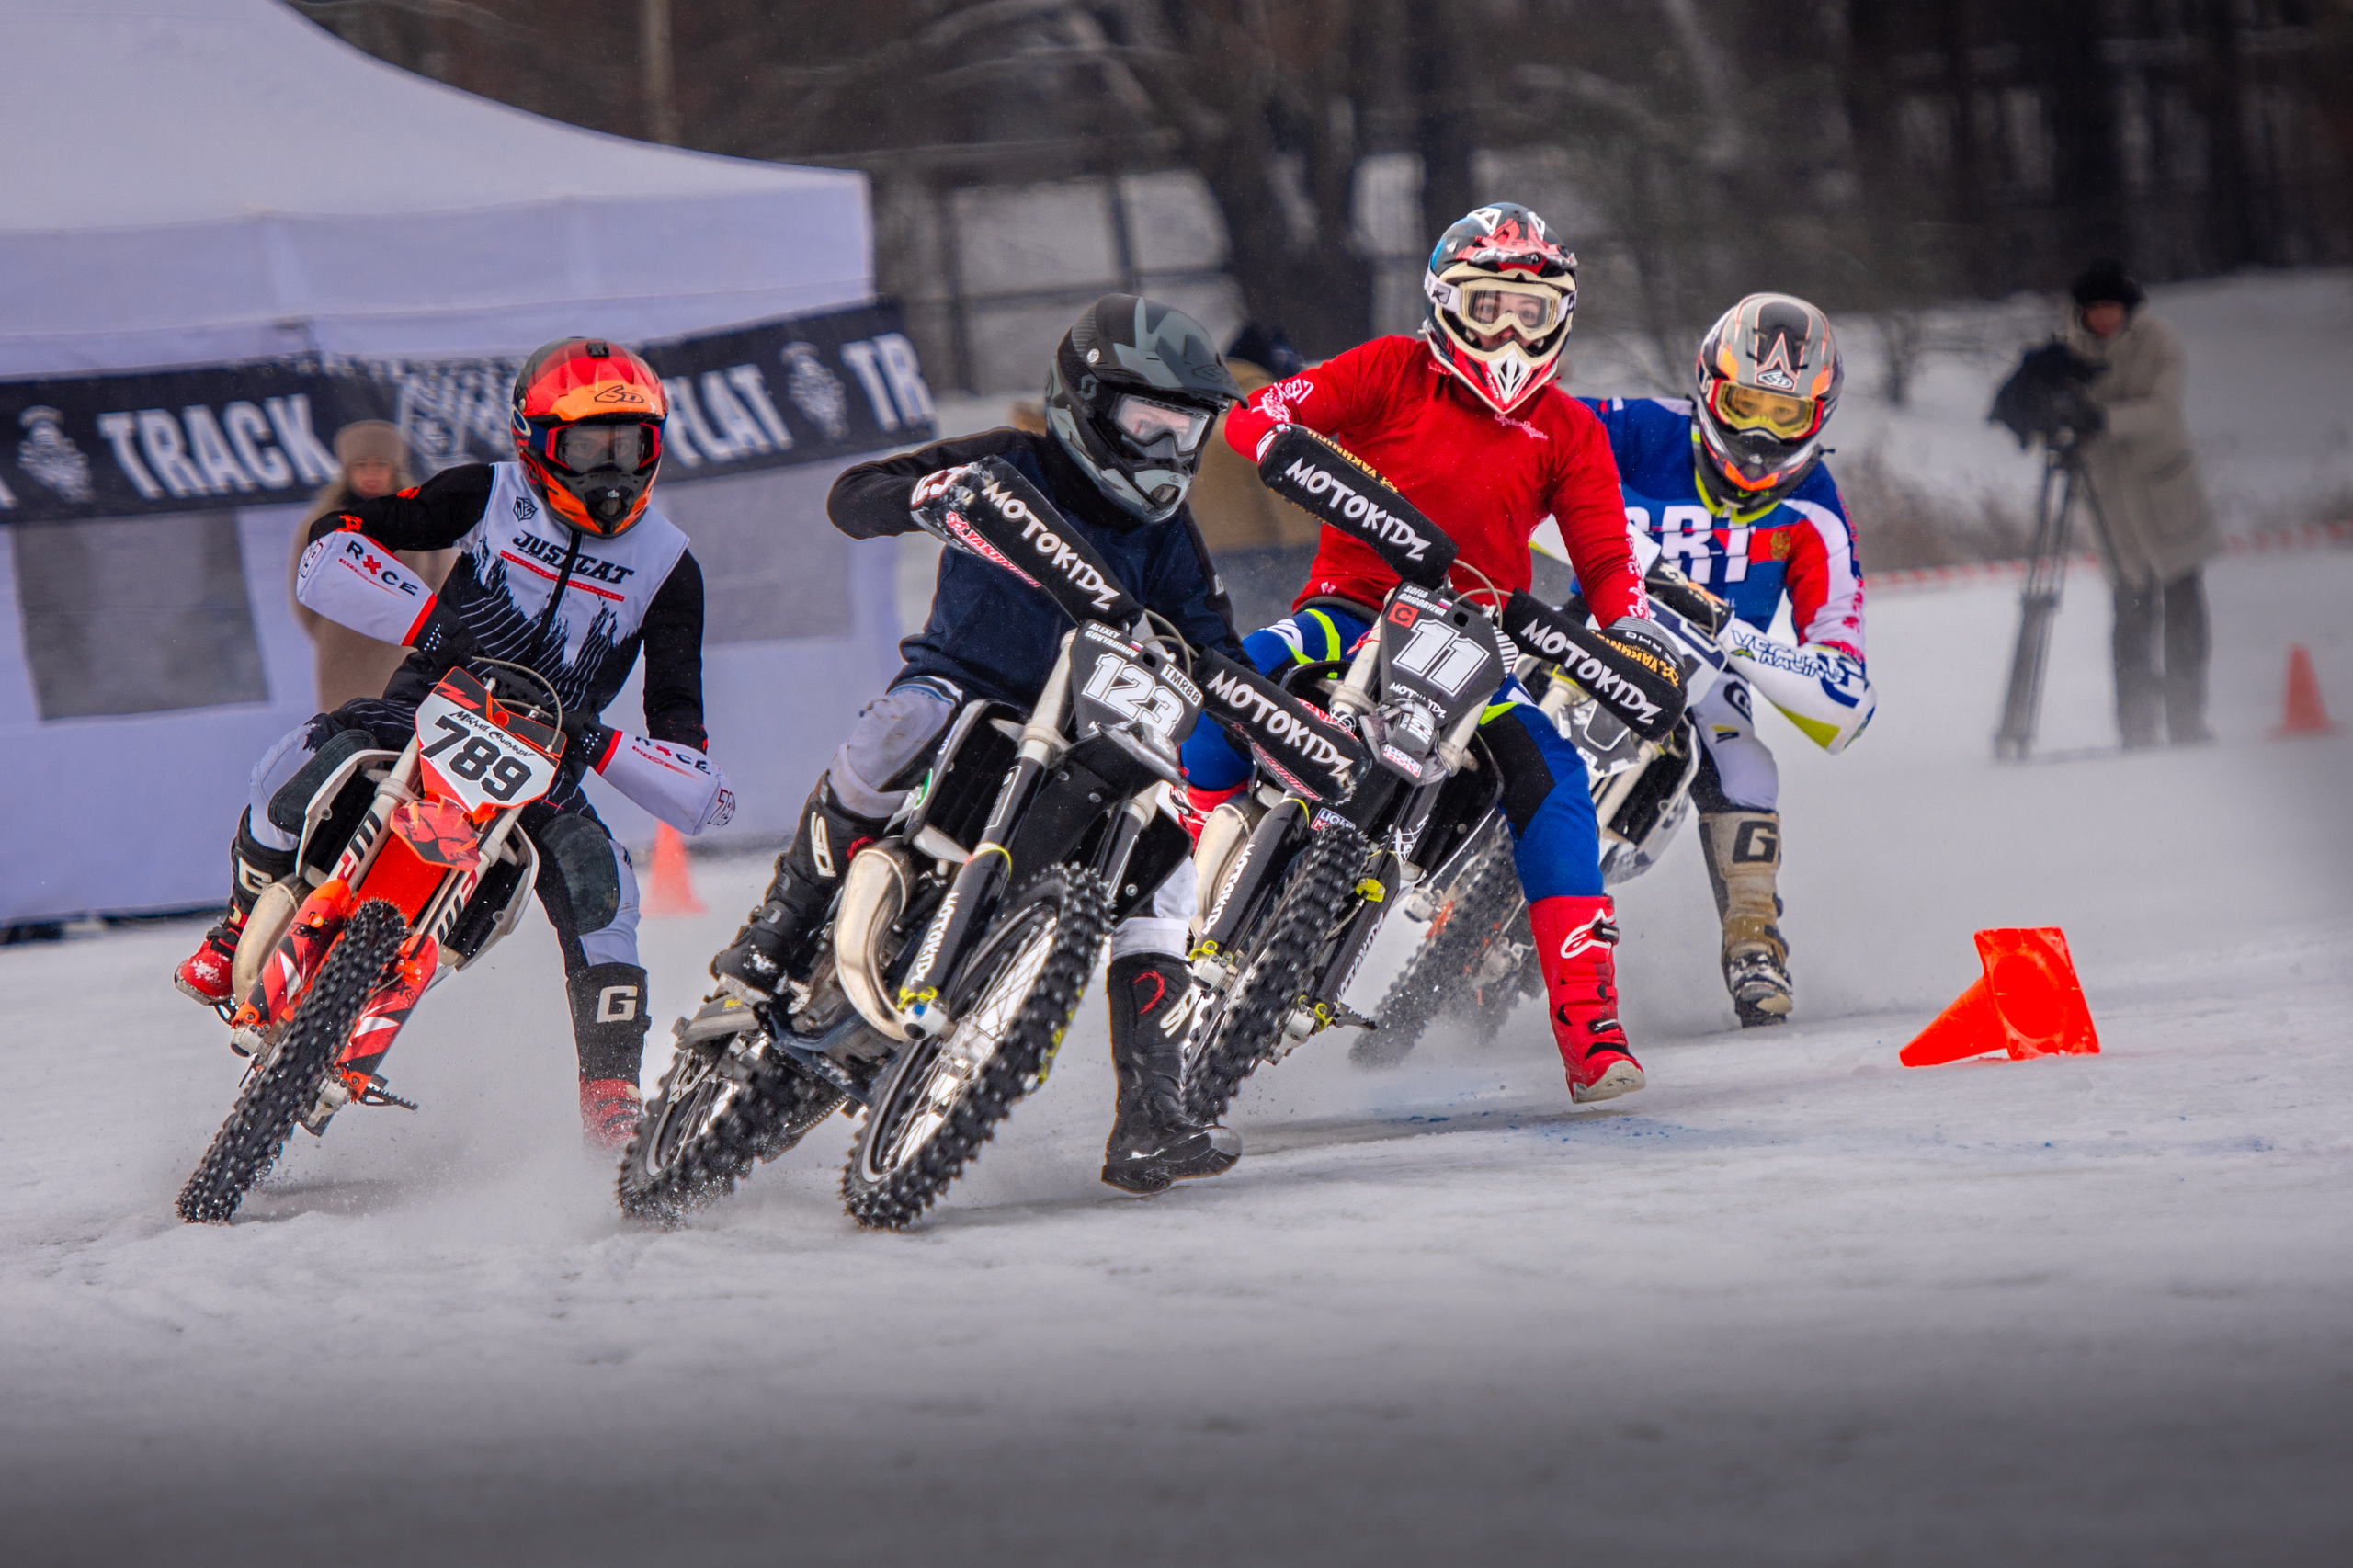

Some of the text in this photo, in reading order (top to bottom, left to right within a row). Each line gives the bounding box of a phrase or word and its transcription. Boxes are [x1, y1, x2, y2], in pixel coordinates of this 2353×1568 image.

[594, 384, 644, 403] 6D
[97, 393, 343, 501] TRACK
[1285, 457, 1431, 562] MOTOKIDZ
[512, 529, 635, 585] JUSCAT
[981, 482, 1120, 611] MOTOKIDZ
[1398, 593, 1448, 617] GRIGORYEVA
[1404, 585, 1428, 597] SOFIA
[1085, 630, 1141, 659] GOVYADINOV
[1088, 622, 1121, 640] ALEXEY
[1392, 619, 1491, 698] 11
[1081, 652, 1185, 737] 123
[1163, 665, 1201, 704] TMR88
[1389, 682, 1447, 719] MOTIDZ
[1520, 618, 1662, 725] MOTOKIDZ
[1206, 669, 1354, 777] MOTOKIDZ
[420, 714, 533, 802] 789
[910, 891, 960, 985] MOTOKIDZ
[597, 985, 638, 1024] G
